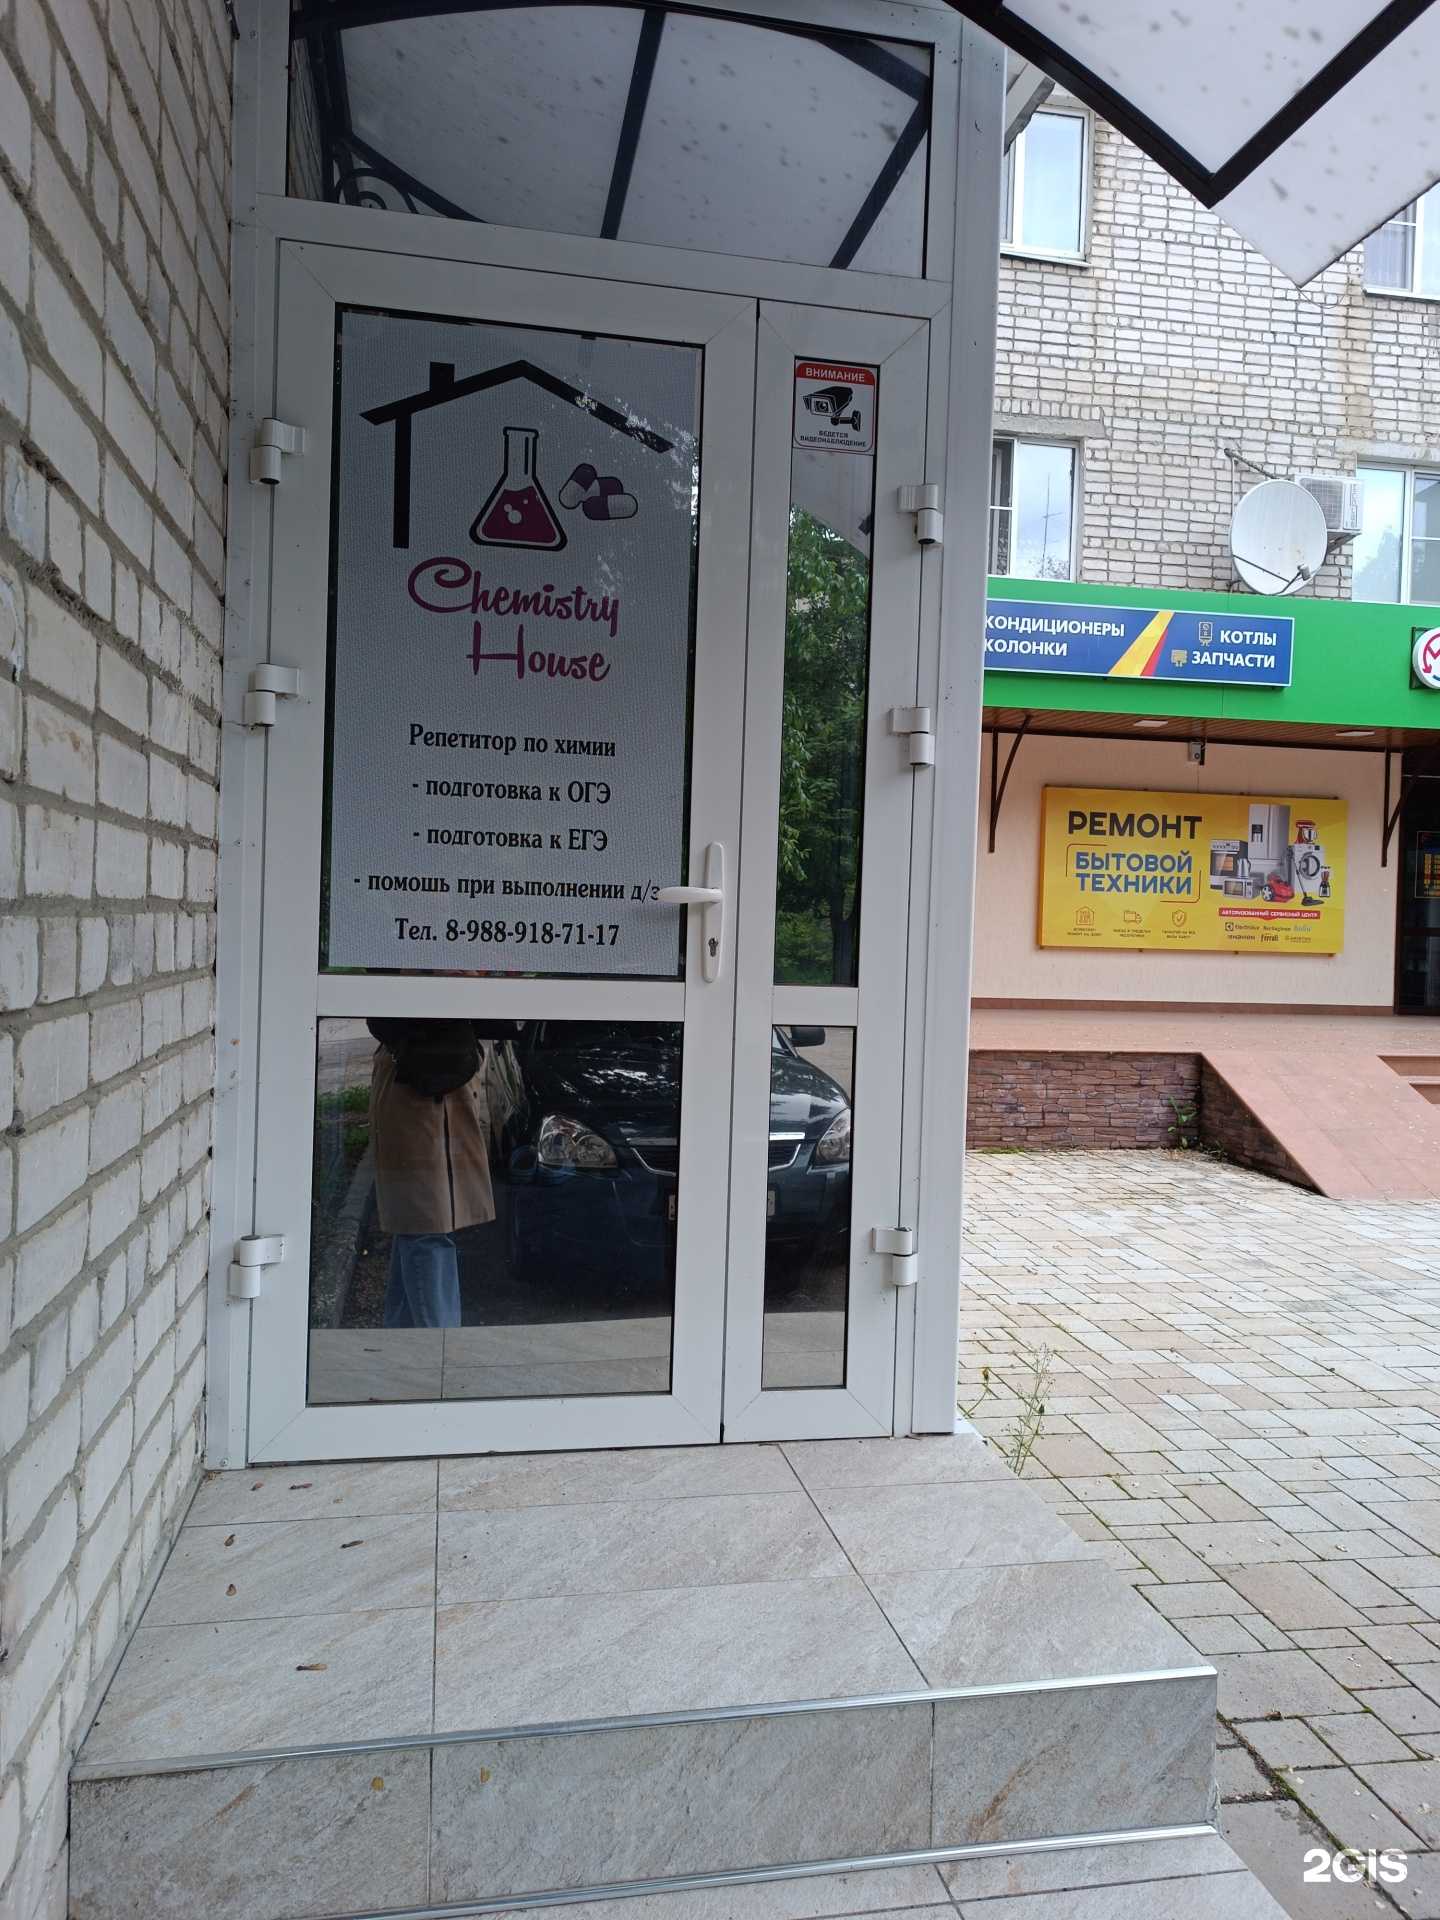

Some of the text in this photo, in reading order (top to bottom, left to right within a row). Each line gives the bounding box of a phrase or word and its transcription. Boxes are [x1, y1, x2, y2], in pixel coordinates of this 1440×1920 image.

[805, 367, 865, 382] ВНИМАНИЕ
[408, 556, 619, 637] Chemistry
[985, 615, 1125, 637] КОНДИЦИОНЕРЫ
[984, 638, 1068, 656] КОЛОНКИ
[1220, 630, 1276, 646] КОТЛЫ
[466, 620, 611, 681] House
[1192, 651, 1275, 668] ЗАПЧАСТИ
[409, 723, 616, 757] Репетитор по химии
[425, 780, 542, 801] подготовка
[548, 786, 560, 801] к
[567, 781, 611, 804] ОГЭ
[1068, 810, 1203, 839] РЕМОНТ
[427, 828, 542, 850] подготовка
[549, 835, 561, 849] к
[568, 828, 608, 851] ЕГЭ
[1076, 850, 1192, 873] БЫТОВОЙ
[457, 879, 495, 899] при
[502, 880, 624, 900] выполнении
[1076, 872, 1192, 894] ТЕХНИКИ
[395, 917, 619, 945] Тел. 8-988-918-71-17
